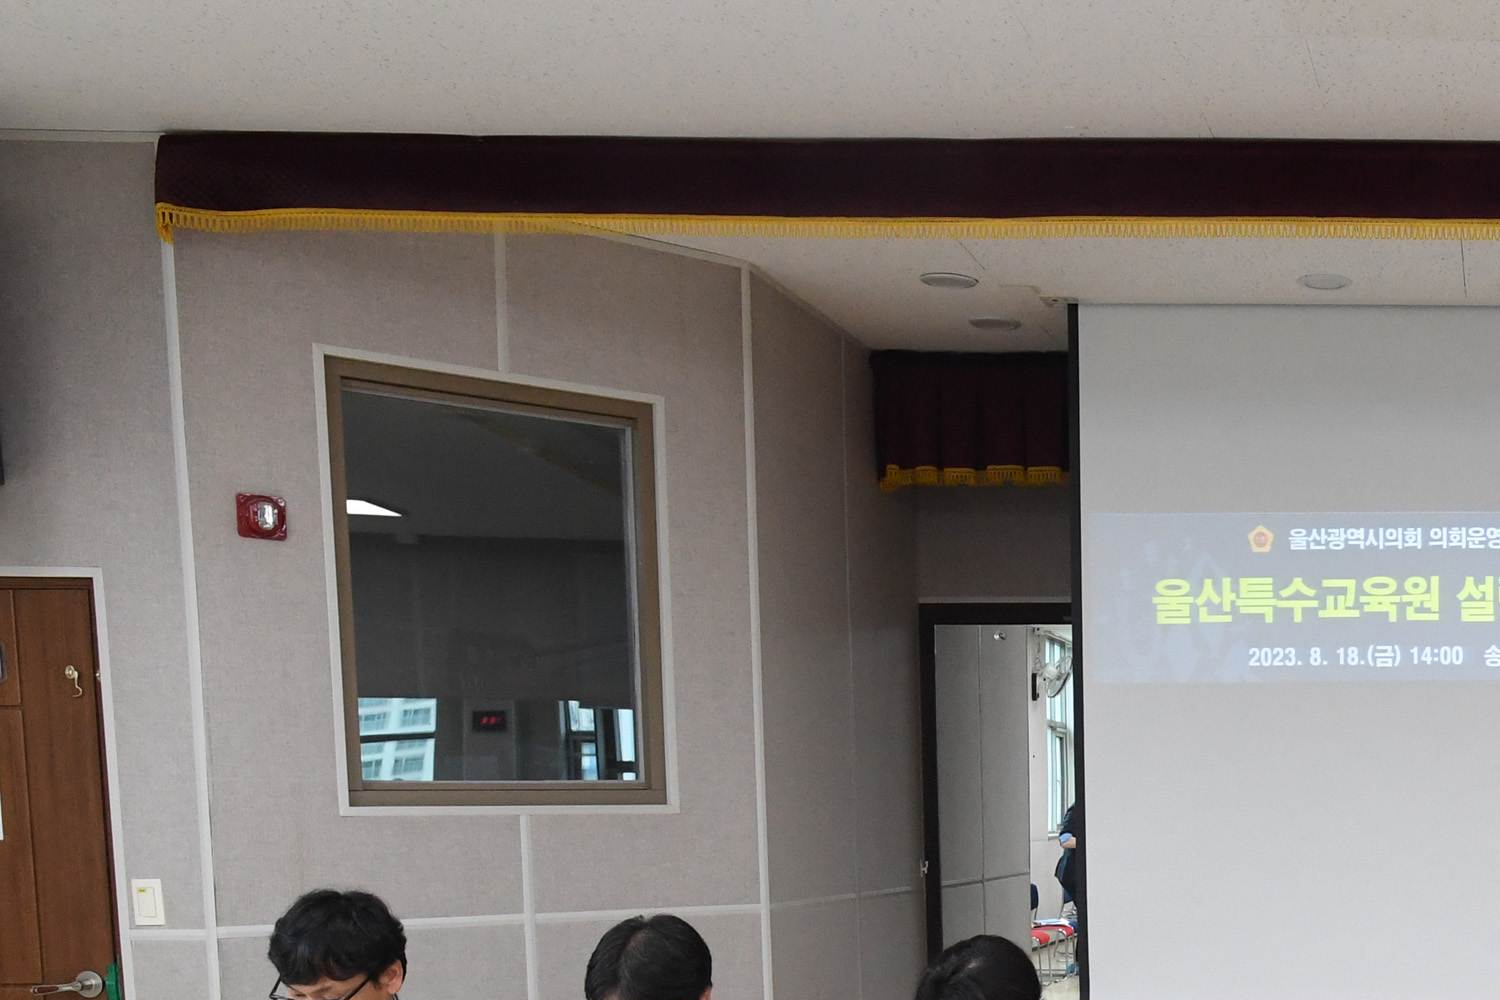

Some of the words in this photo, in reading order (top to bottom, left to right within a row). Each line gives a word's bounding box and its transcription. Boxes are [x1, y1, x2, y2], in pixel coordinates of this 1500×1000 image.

[1288, 526, 1423, 551] 울산광역시의회
[1152, 575, 1441, 624] 울산특수교육원
[1248, 647, 1302, 667] 2023.
[1309, 647, 1328, 667] 8.
[1336, 645, 1401, 667] 18.(금)
[1410, 646, 1464, 666] 14:00
